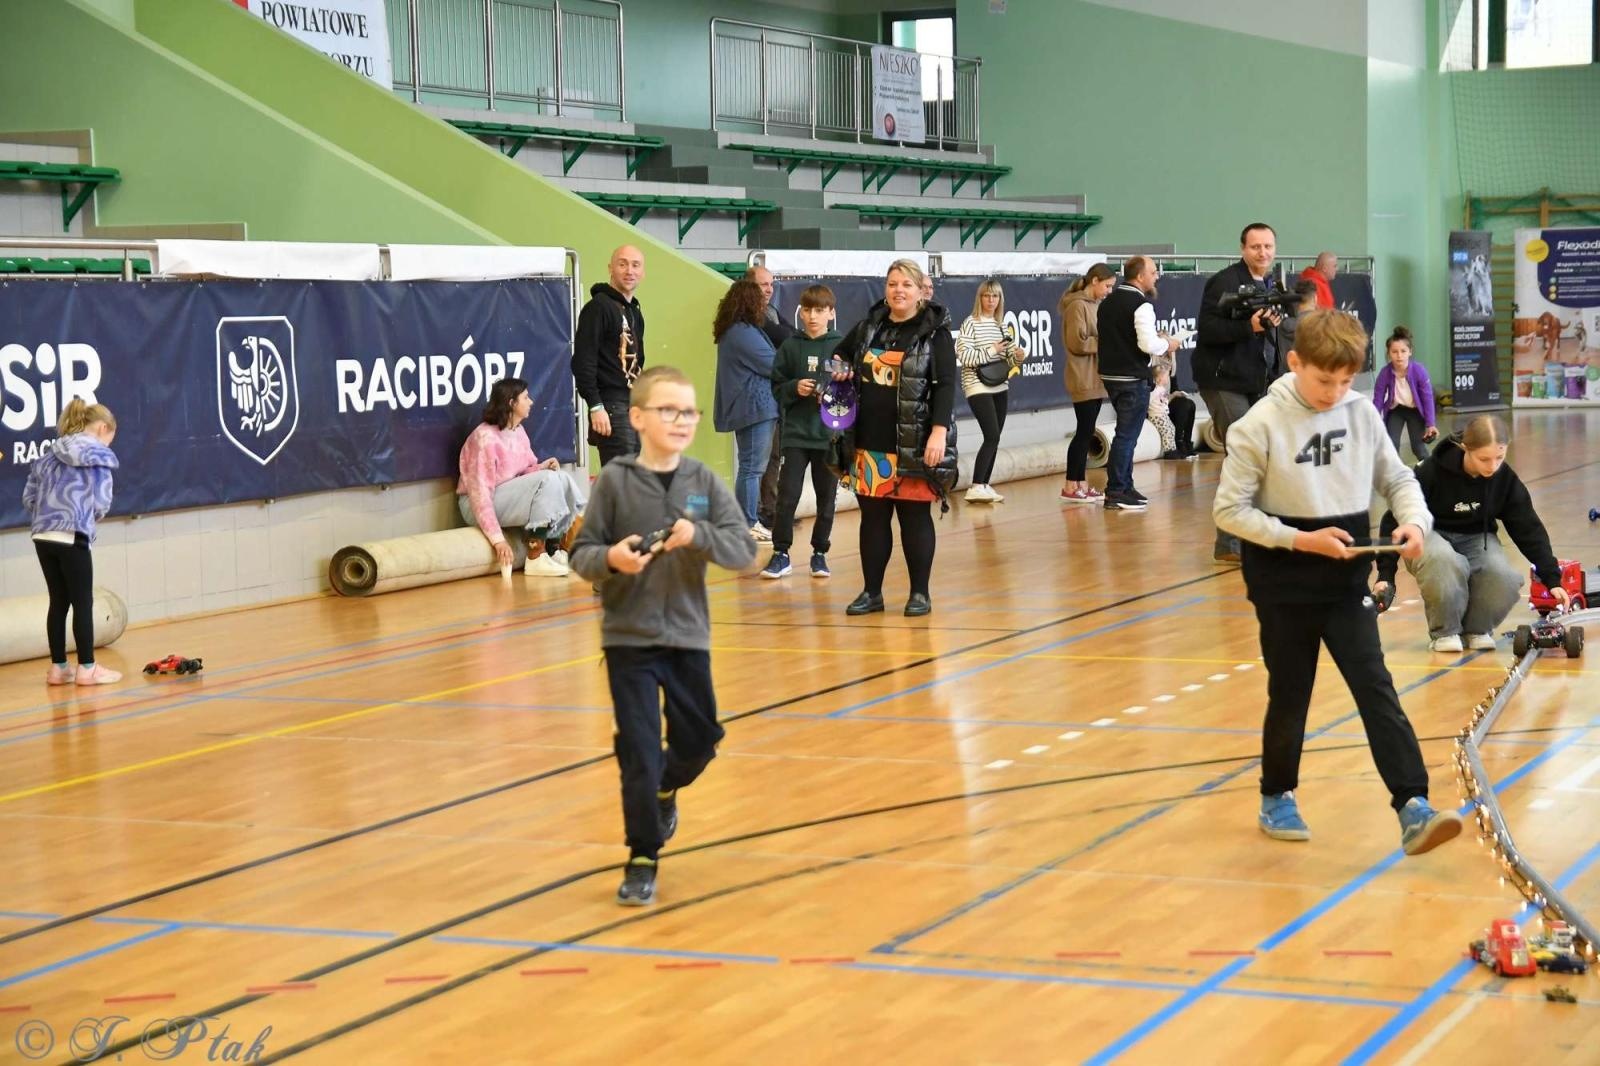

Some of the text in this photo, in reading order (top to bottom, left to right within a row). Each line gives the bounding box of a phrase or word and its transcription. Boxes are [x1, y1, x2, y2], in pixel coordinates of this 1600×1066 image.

[261, 1, 369, 39] POWIATOWE
[1003, 310, 1053, 358] OSiR
[1022, 358, 1054, 377] RACIBÓRZ
[13, 438, 56, 465] RAC
